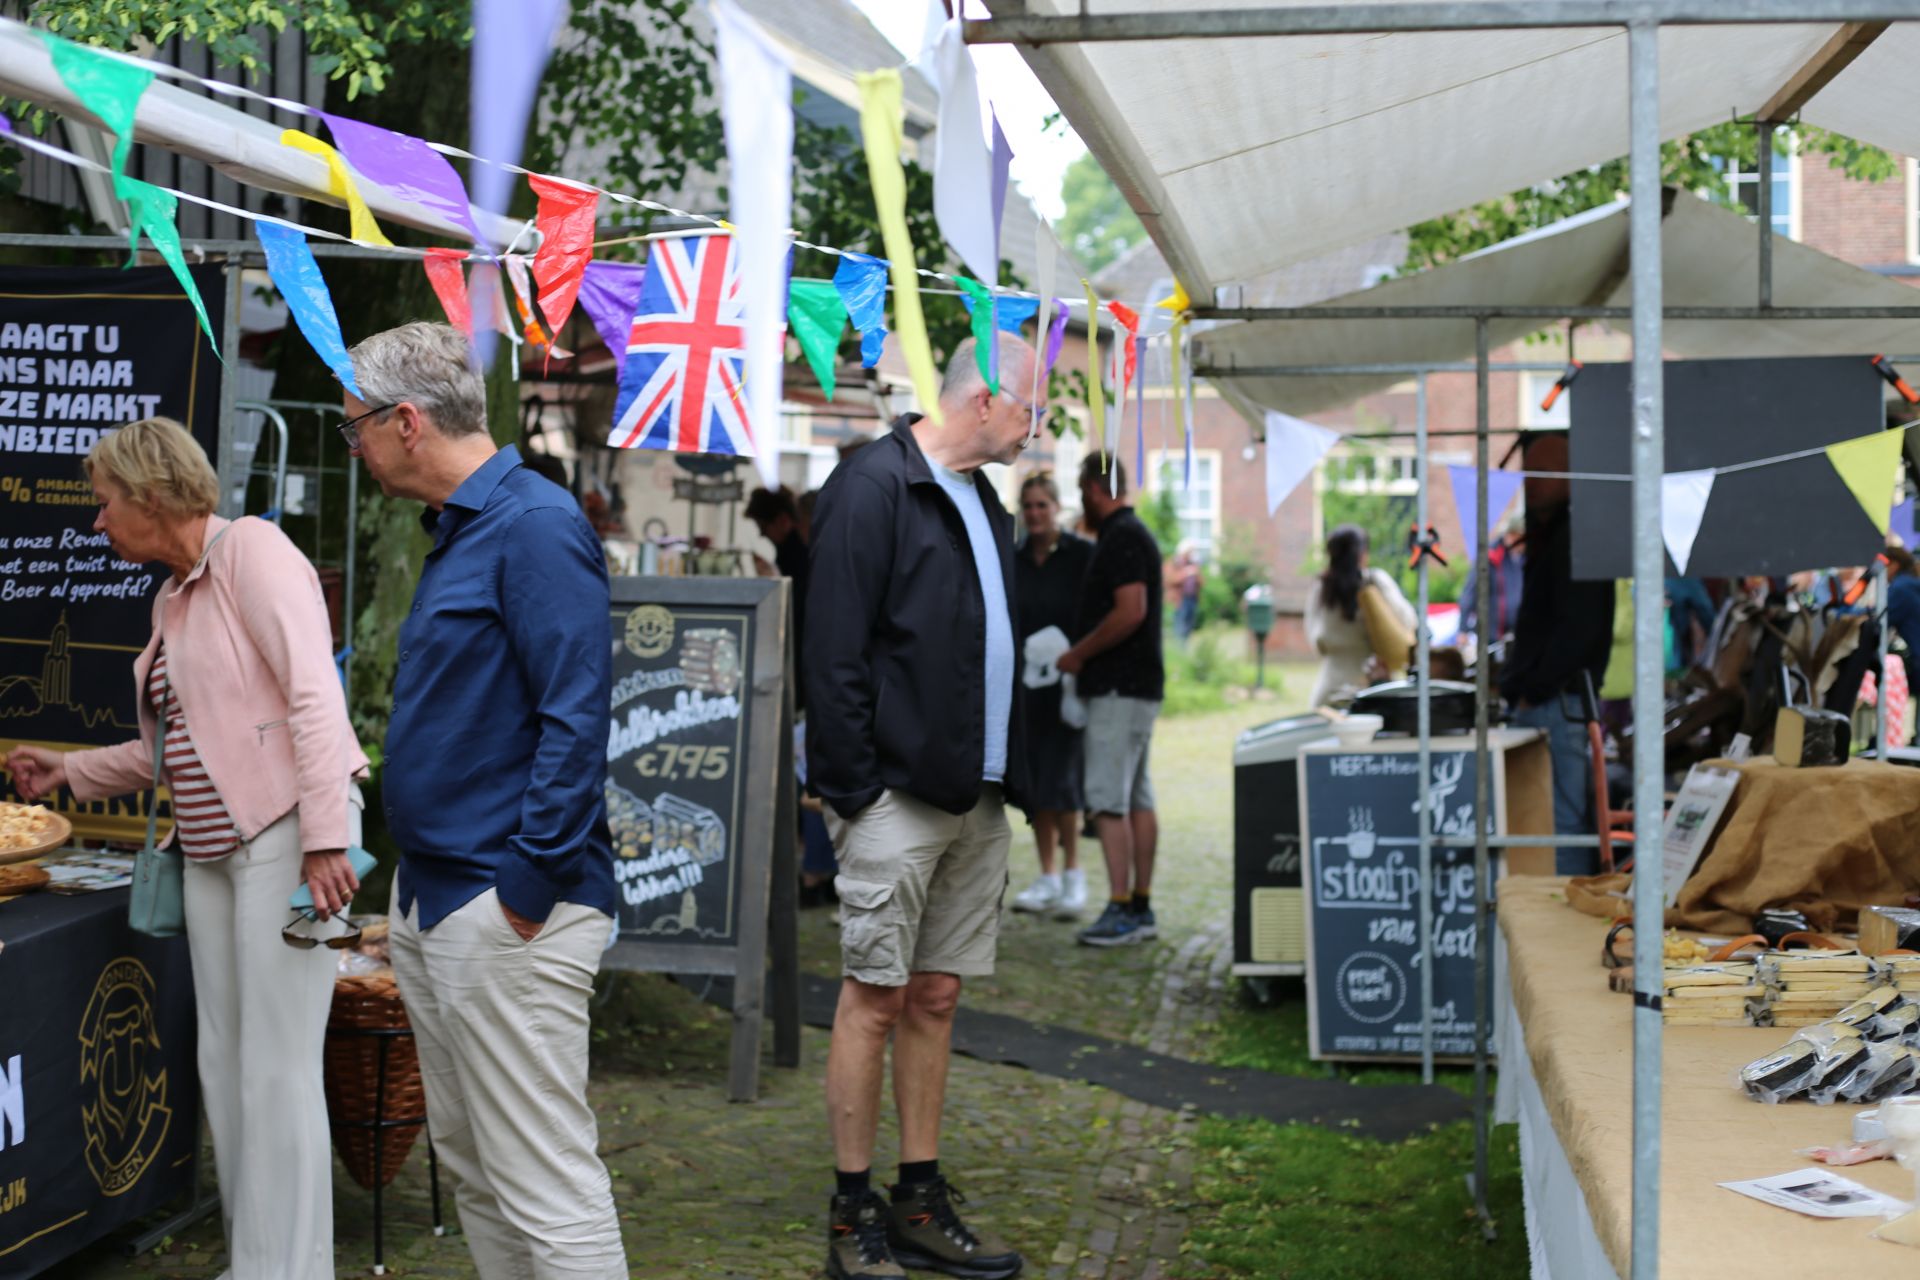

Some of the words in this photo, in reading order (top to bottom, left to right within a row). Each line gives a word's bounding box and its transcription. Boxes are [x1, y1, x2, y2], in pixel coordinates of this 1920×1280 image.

[1, 322, 89, 352] AAGT
[95, 325, 119, 353] U
[44, 359, 133, 387] NAAR
[44, 394, 161, 422] MARKT
[0, 424, 116, 455] NBIED
[13, 536, 53, 549] onze
[28, 561, 59, 574] een
[65, 554, 107, 573] twist
[1, 578, 45, 601] Boer
[49, 577, 70, 598] al
[69, 574, 152, 603] geproefd?
[1323, 850, 1476, 914] stoofptje
